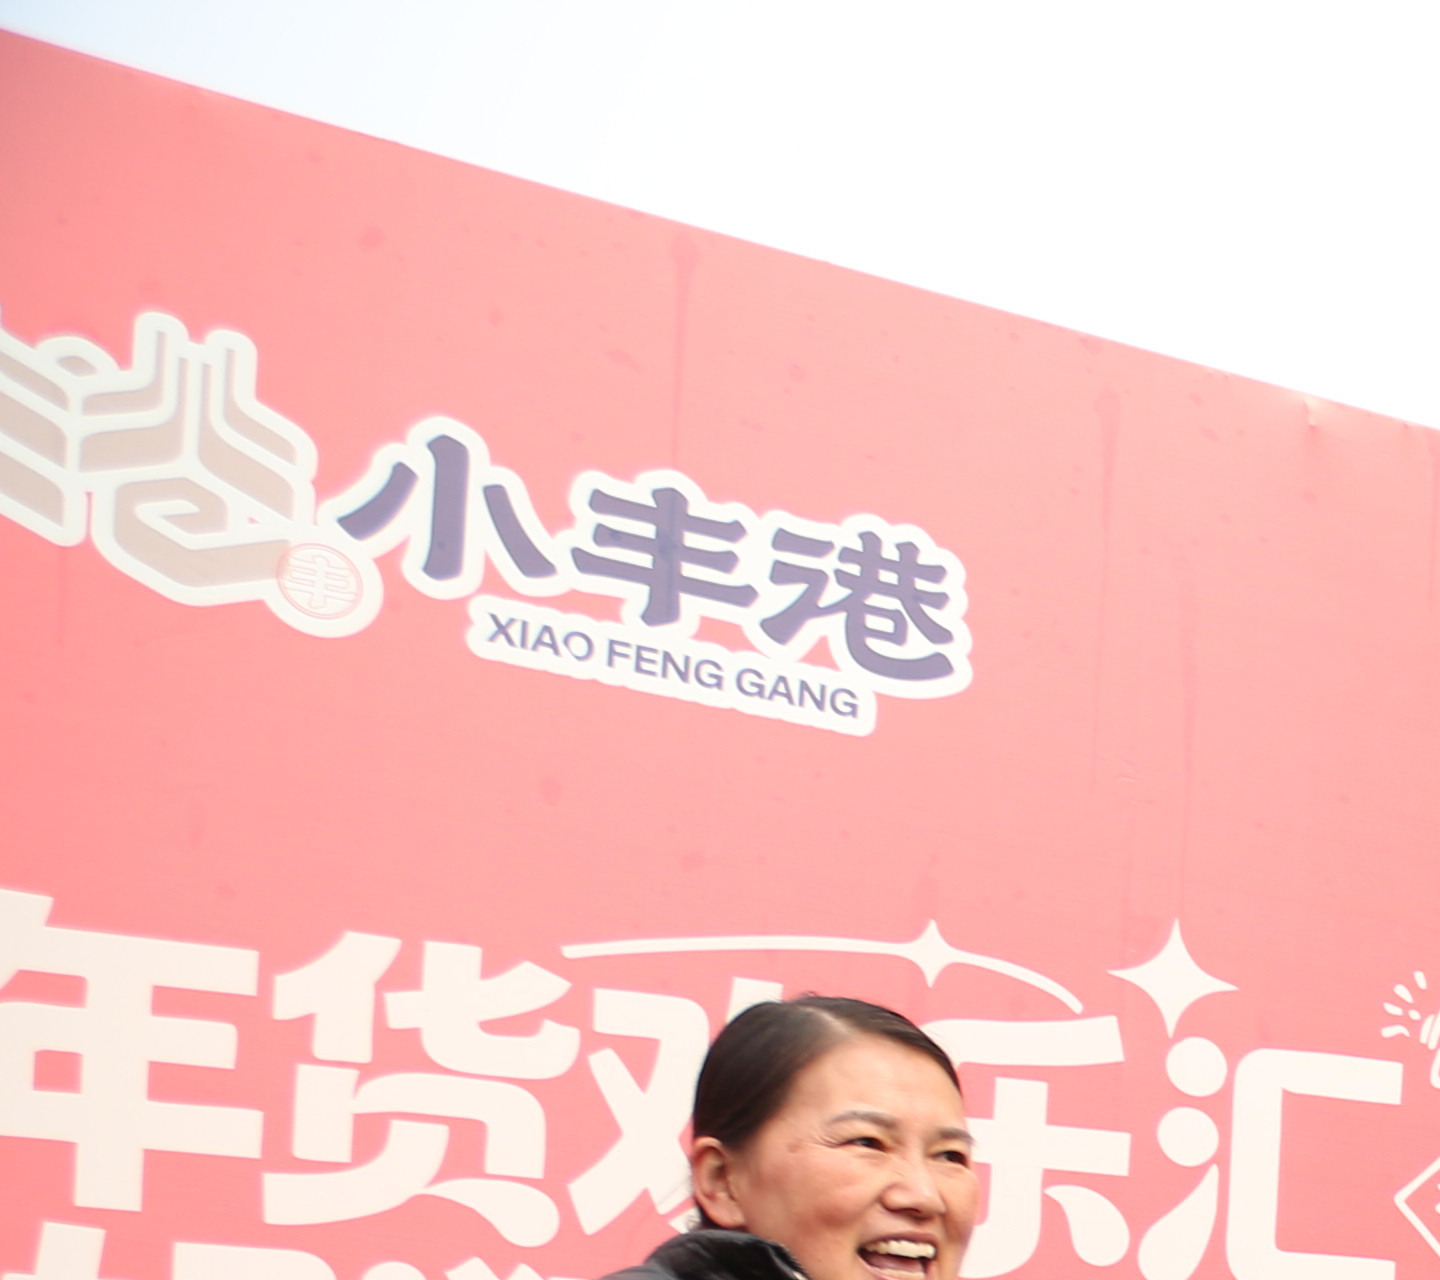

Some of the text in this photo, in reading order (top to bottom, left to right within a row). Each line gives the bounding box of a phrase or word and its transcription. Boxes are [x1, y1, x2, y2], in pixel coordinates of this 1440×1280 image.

[336, 432, 956, 681] 小丰港
[486, 611, 860, 720] XIAO FENG GANG
